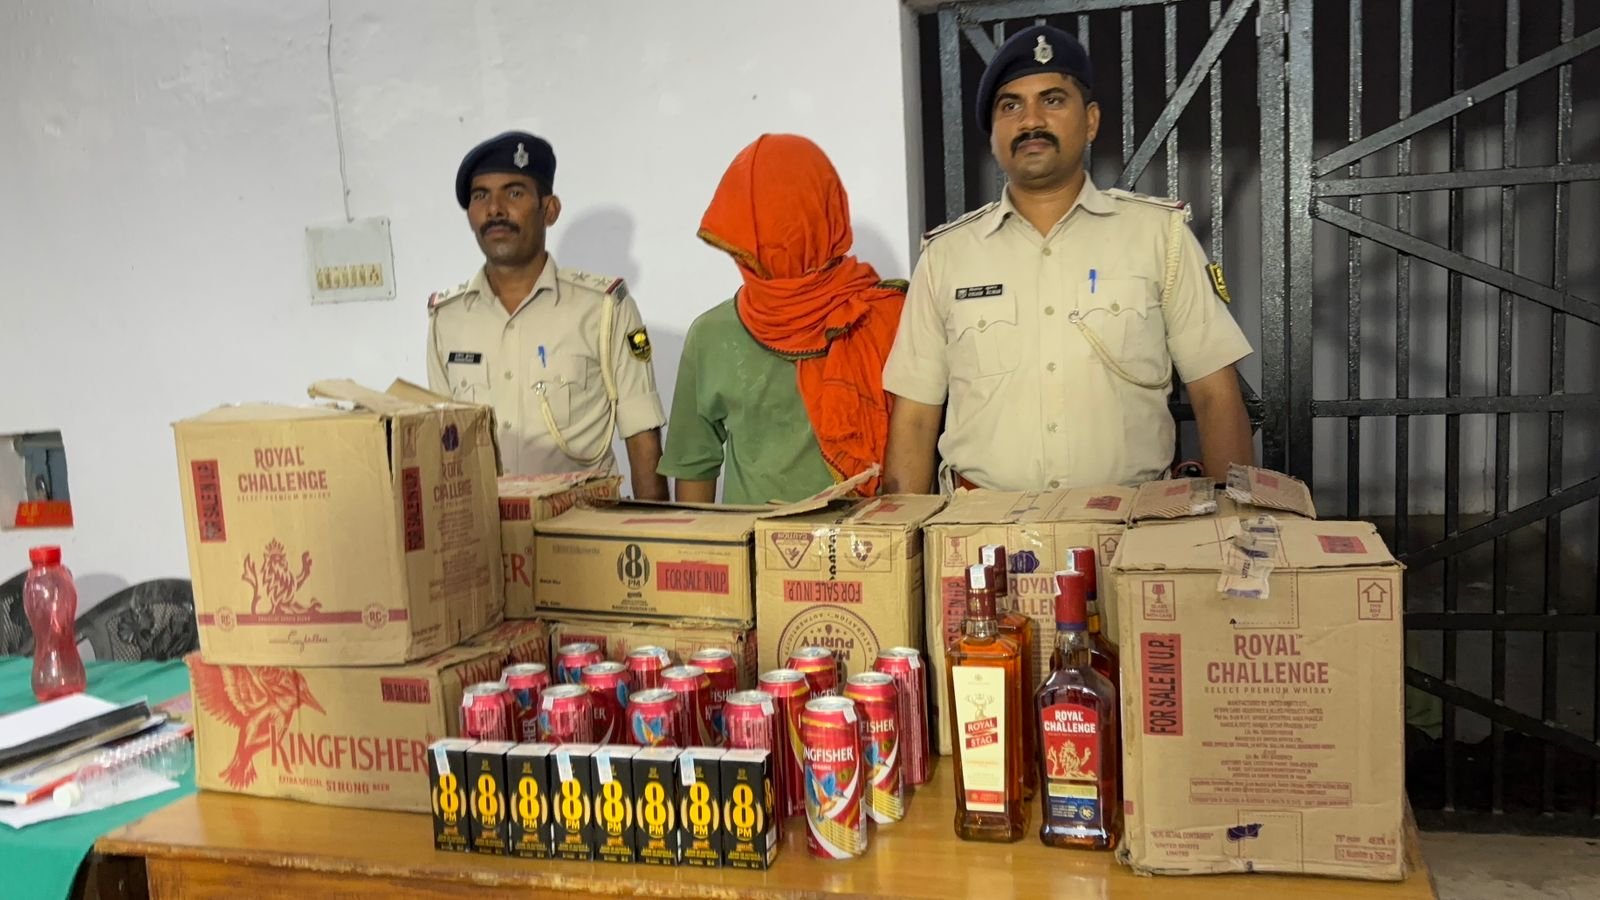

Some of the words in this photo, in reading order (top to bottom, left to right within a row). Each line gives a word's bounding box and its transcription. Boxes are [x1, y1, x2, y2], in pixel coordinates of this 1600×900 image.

[254, 446, 304, 472] ROYAL
[238, 469, 328, 493] CHALLENGE
[625, 543, 643, 579] 8
[627, 579, 641, 587] PM
[801, 581, 810, 601] IN
[815, 581, 839, 602] SALE
[841, 582, 861, 602] FOR
[369, 612, 382, 623] RC
[800, 636, 854, 648] PURITY
[1233, 633, 1301, 661] ROYAL
[1148, 662, 1175, 674] IN
[1206, 661, 1329, 684] CHALLENGE
[1149, 676, 1177, 708] SALE
[1204, 686, 1240, 694] SELECT
[1243, 686, 1289, 695] PREMIUM
[1293, 687, 1333, 695] WHISKY
[860, 718, 895, 733] FISHER
[1054, 709, 1084, 723] ROYAL
[1150, 710, 1177, 734] FOR
[967, 721, 995, 733] ROYAL
[1044, 720, 1096, 734] CHALLENGE
[269, 725, 430, 777] KINGFISHER
[970, 735, 993, 748] STAG
[279, 775, 298, 784] EXTRA
[299, 776, 322, 786] SPECIAL
[326, 780, 370, 794] STRONG
[372, 783, 390, 792] BEER
[439, 772, 459, 813] 8
[477, 773, 498, 816] 8
[518, 776, 540, 820] 8
[561, 777, 583, 820] 8
[602, 779, 625, 823] 8
[644, 781, 667, 825] 8
[689, 781, 711, 826] 8
[732, 783, 755, 828] 8
[443, 812, 457, 822] PM
[481, 815, 496, 825] PM
[522, 819, 538, 829] PM
[565, 819, 580, 830] PM
[607, 822, 622, 833] PM
[648, 824, 664, 835] PM
[693, 825, 708, 835] PM
[736, 827, 752, 838] PM
